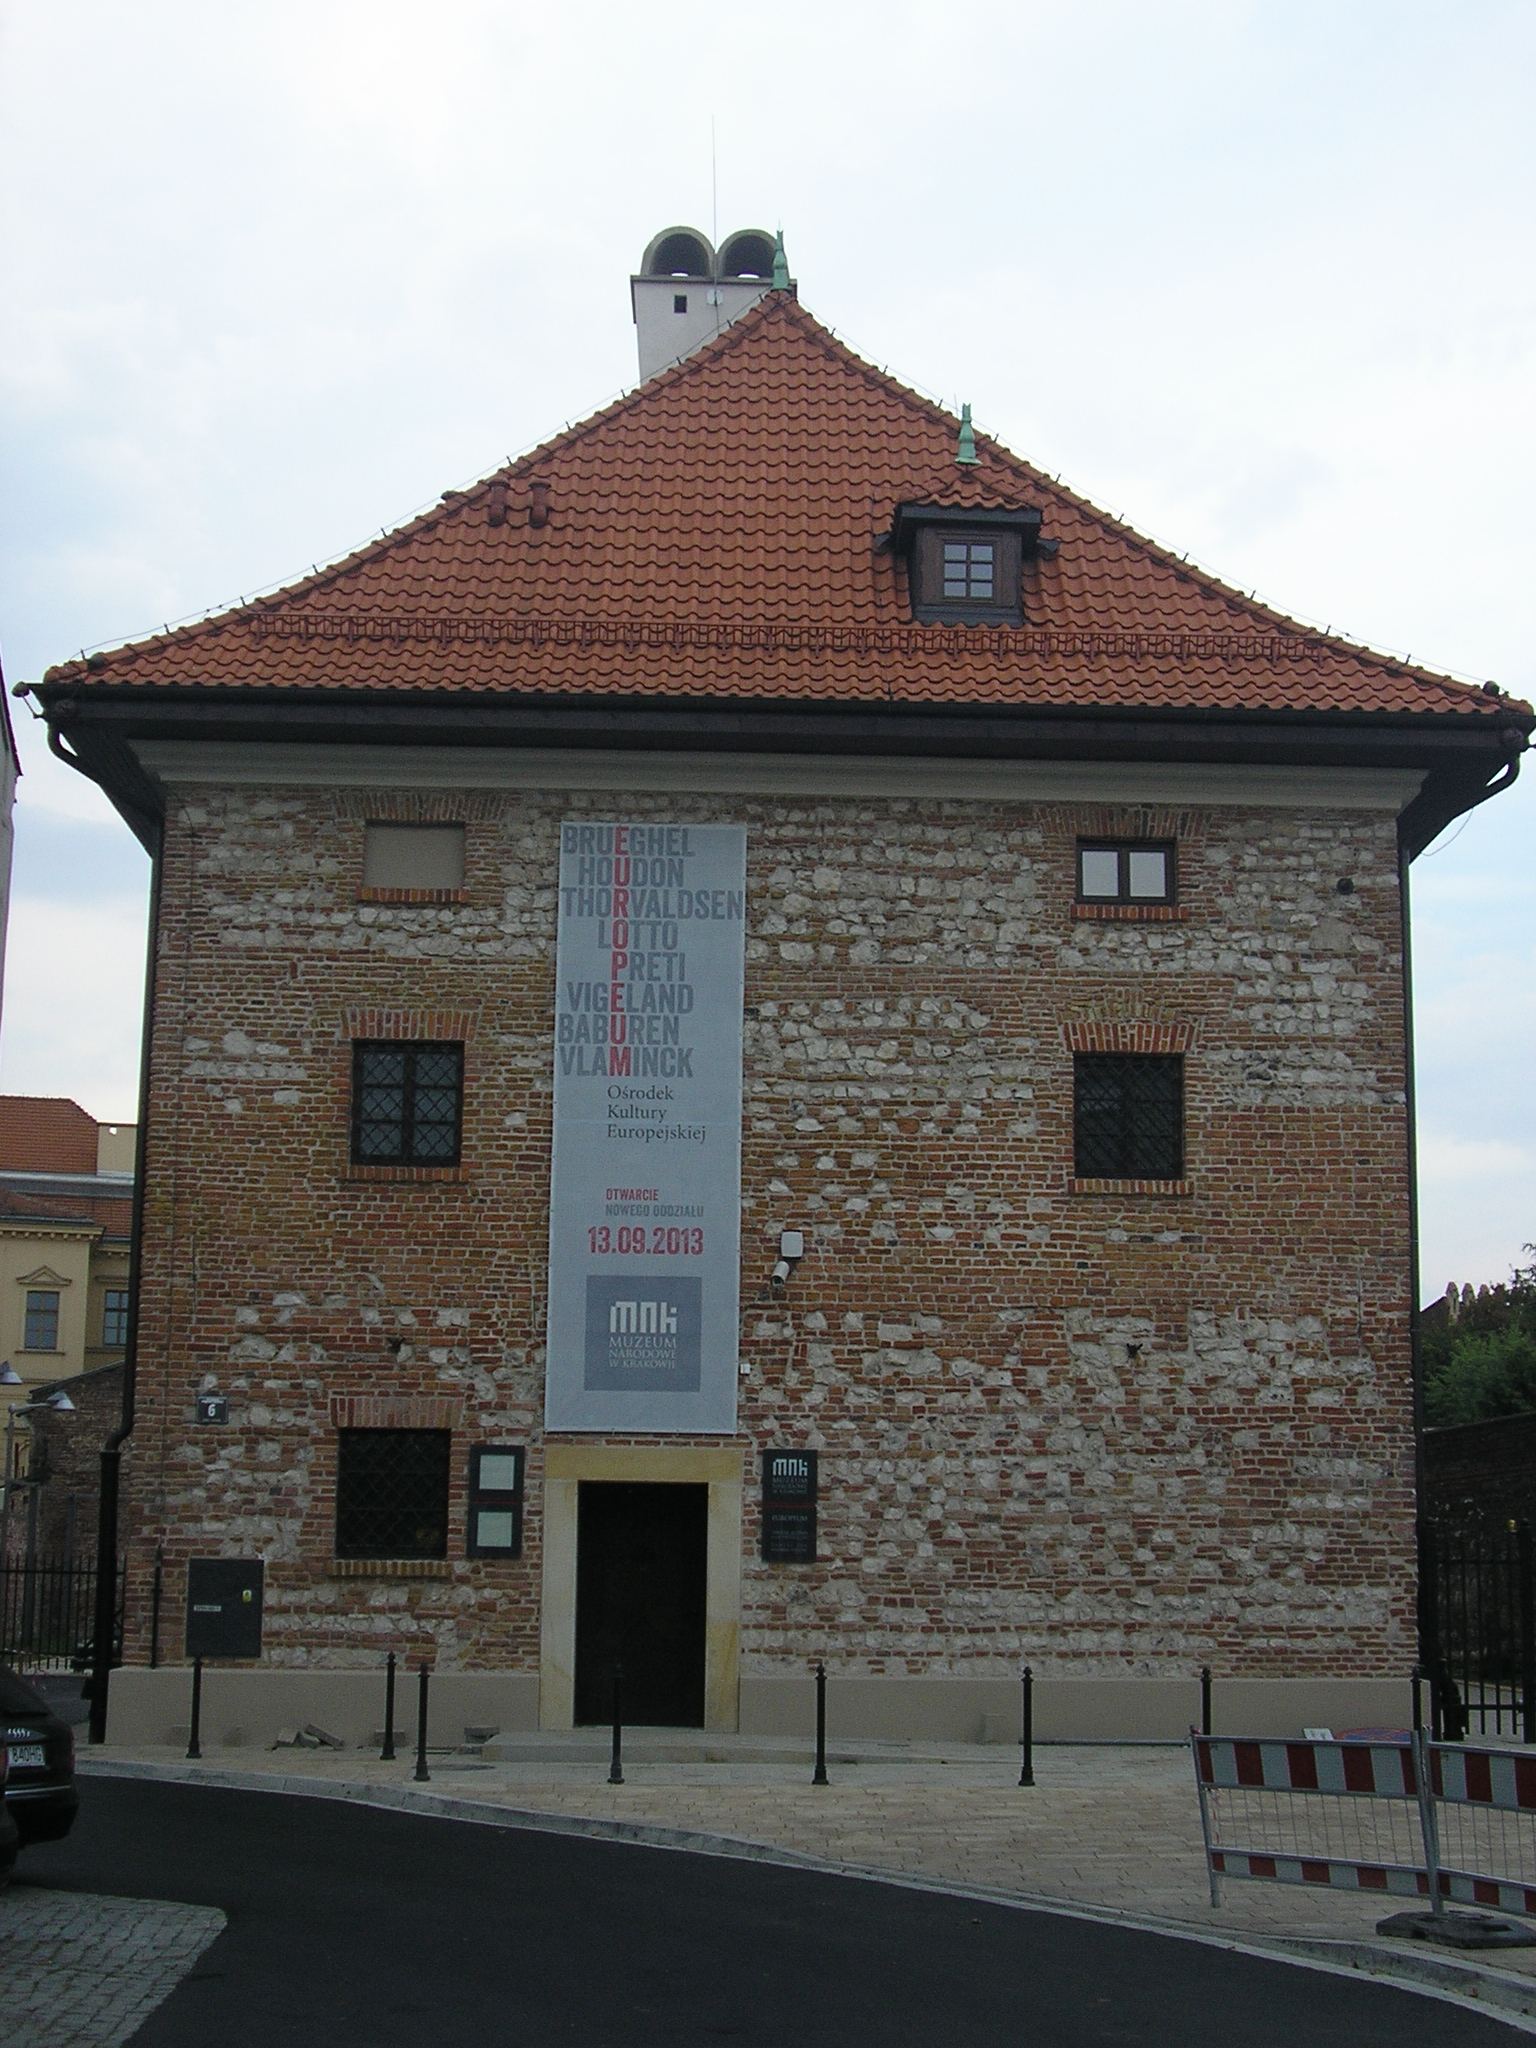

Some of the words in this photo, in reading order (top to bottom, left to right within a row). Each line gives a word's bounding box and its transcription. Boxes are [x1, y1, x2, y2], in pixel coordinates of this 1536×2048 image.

[561, 826, 696, 857] BRUEGHEL
[578, 857, 684, 887] HOUDON
[561, 887, 744, 920] THORVALDSEN
[598, 919, 679, 950] LOTTO
[610, 951, 686, 982] PRETI
[567, 982, 694, 1014] VIGELAND
[558, 1013, 680, 1045] BABUREN
[558, 1045, 694, 1078] VLAMINCK
[607, 1084, 674, 1101] Ośrodek
[607, 1104, 667, 1123] Kultury
[607, 1124, 706, 1145] Europejskiej
[606, 1188, 660, 1201] OTWARCIE
[605, 1203, 651, 1217] NOWEGO
[587, 1226, 705, 1256] 13.09.2013
[608, 1336, 677, 1349] MUZEUM
[208, 1403, 217, 1417] 6
